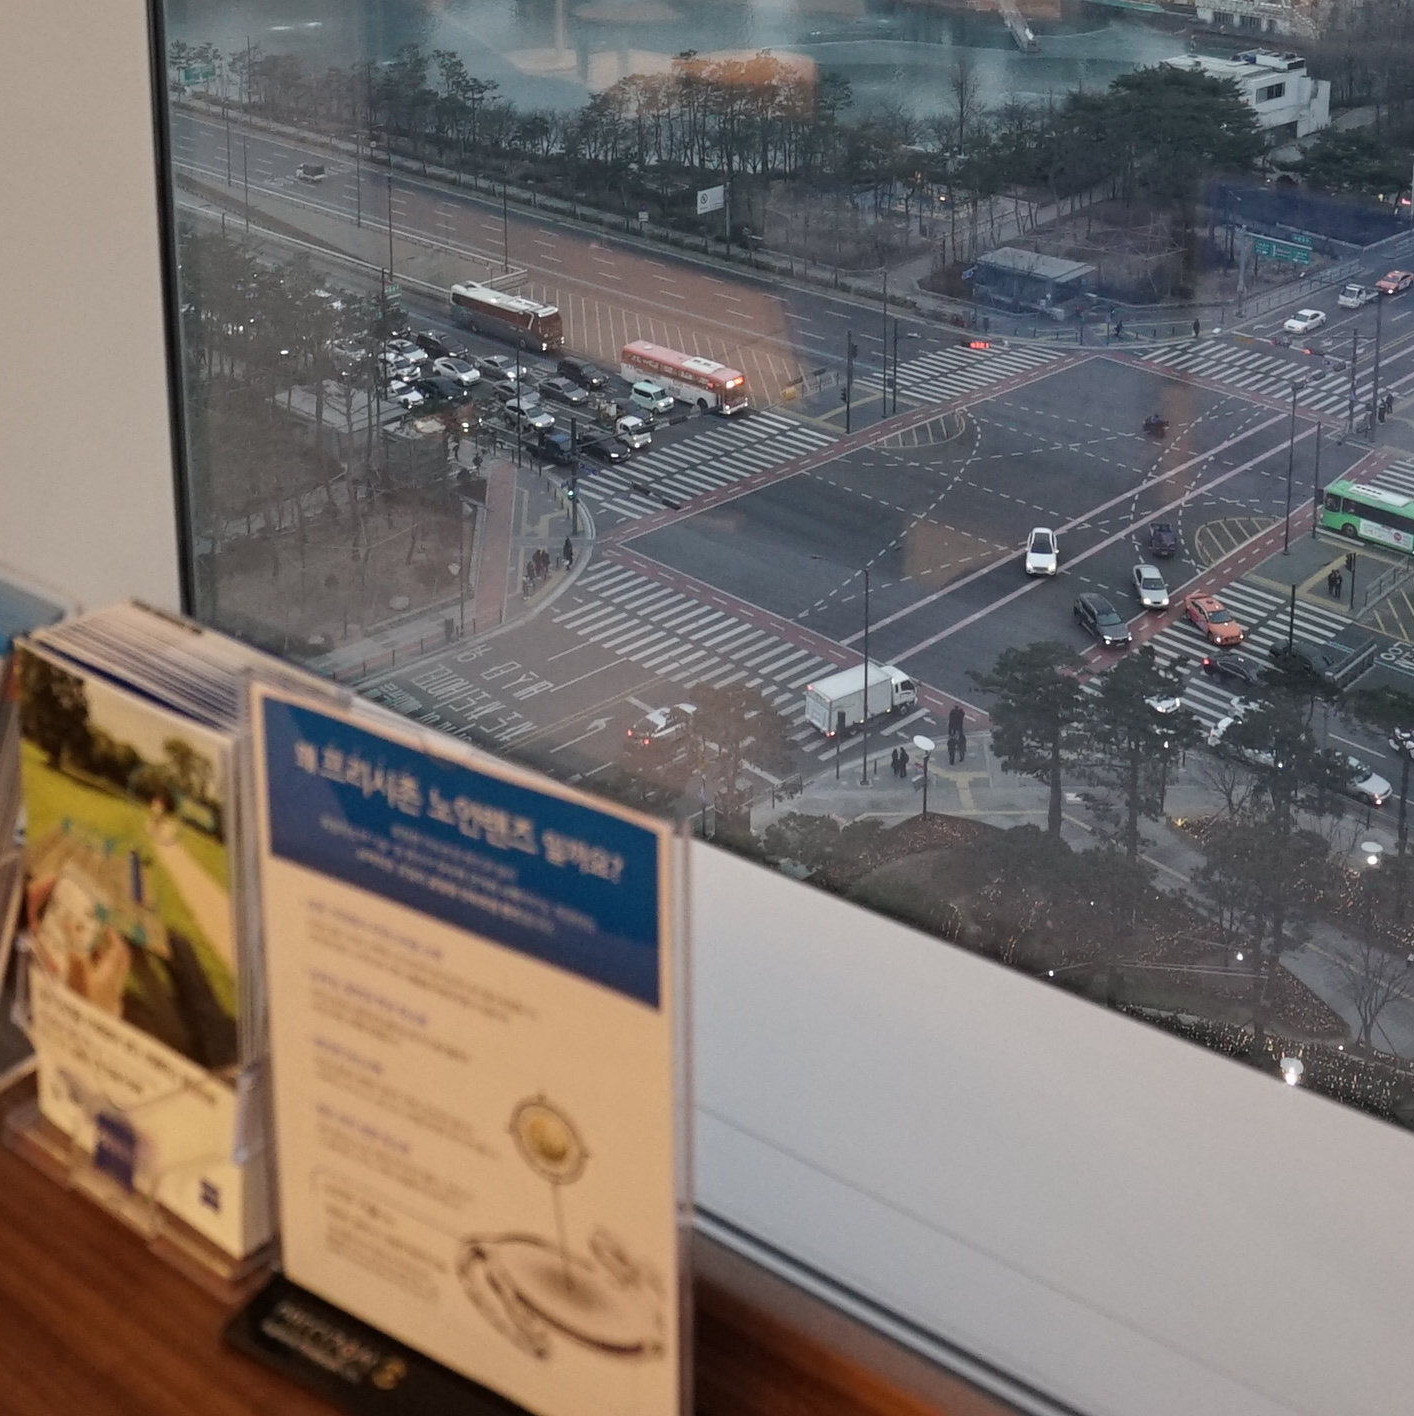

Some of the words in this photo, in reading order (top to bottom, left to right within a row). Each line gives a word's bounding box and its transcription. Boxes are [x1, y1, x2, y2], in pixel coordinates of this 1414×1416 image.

[456, 643, 523, 682] 타워
[410, 663, 472, 701] HOTEL
[500, 670, 556, 701] 버스
[448, 689, 507, 721] 차도
[479, 710, 538, 743] 차도
[427, 787, 540, 856] 노안렌즈
